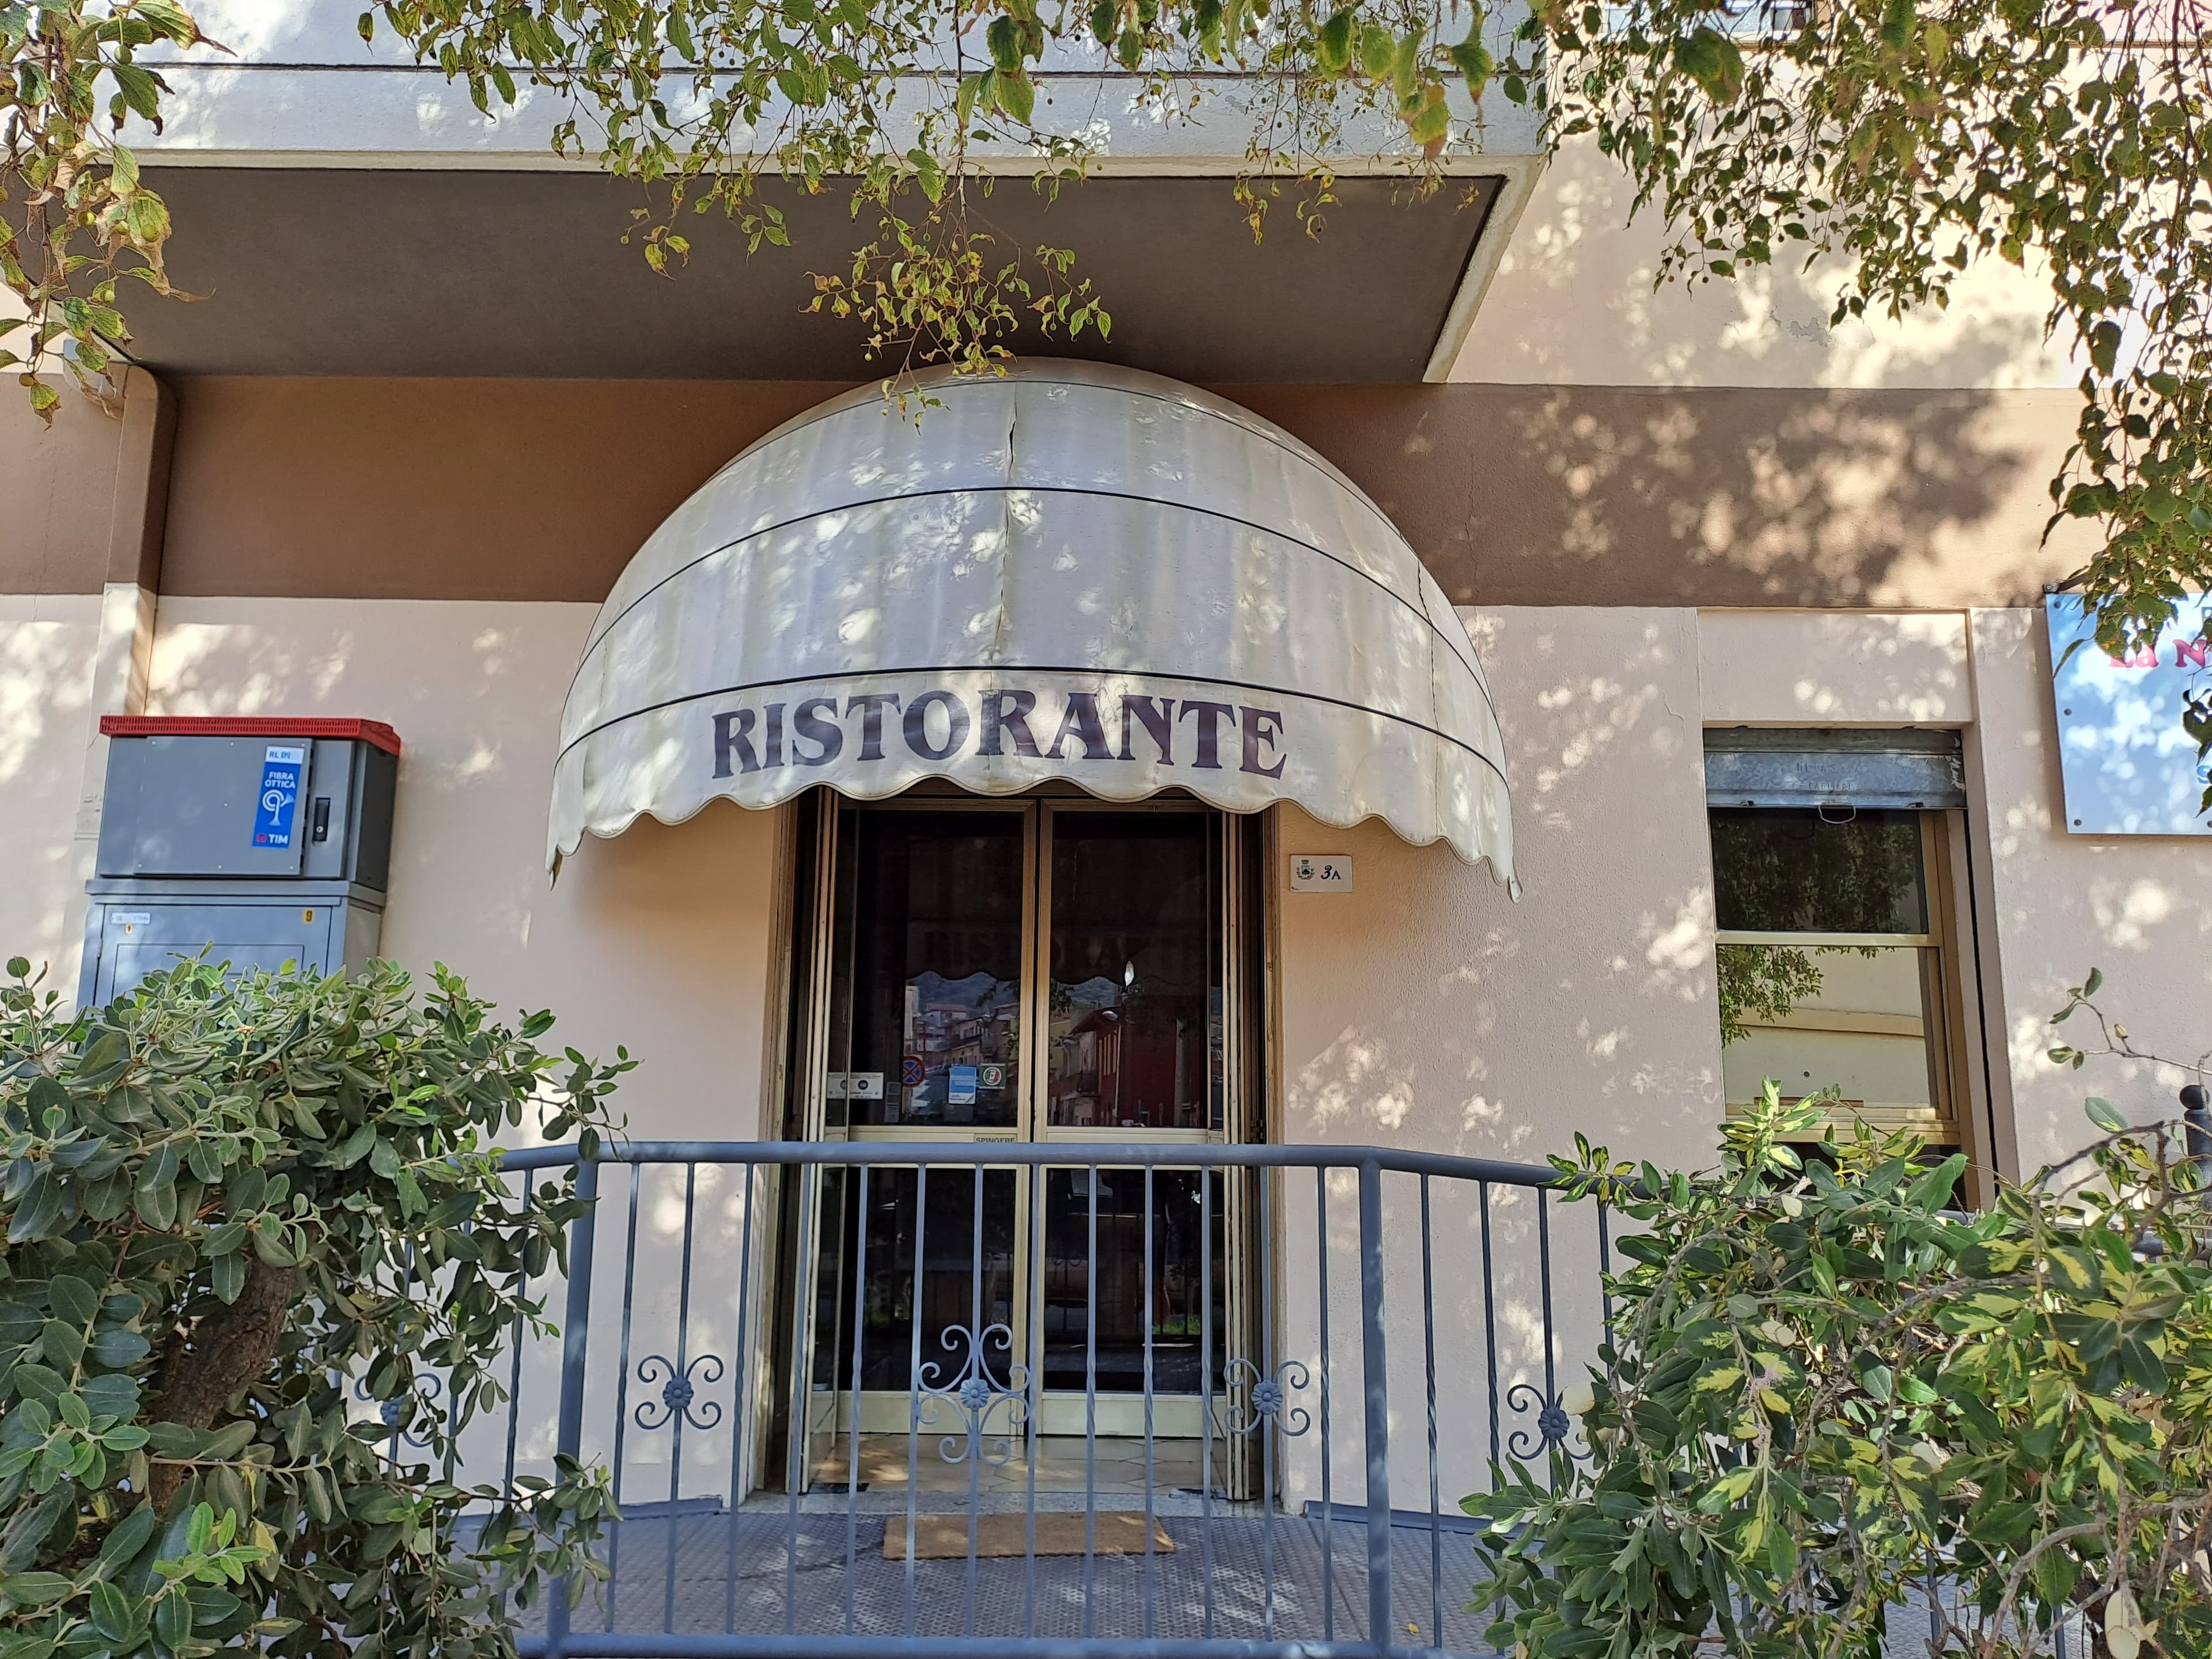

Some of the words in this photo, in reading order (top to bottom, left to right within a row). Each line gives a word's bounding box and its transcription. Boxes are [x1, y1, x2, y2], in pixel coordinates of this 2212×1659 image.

[711, 690, 1287, 779] RISTORANTE
[268, 771, 294, 780] FIBRA
[264, 779, 296, 789] OTTICA
[268, 834, 289, 844] TIM
[1321, 865, 1342, 880] 3A
